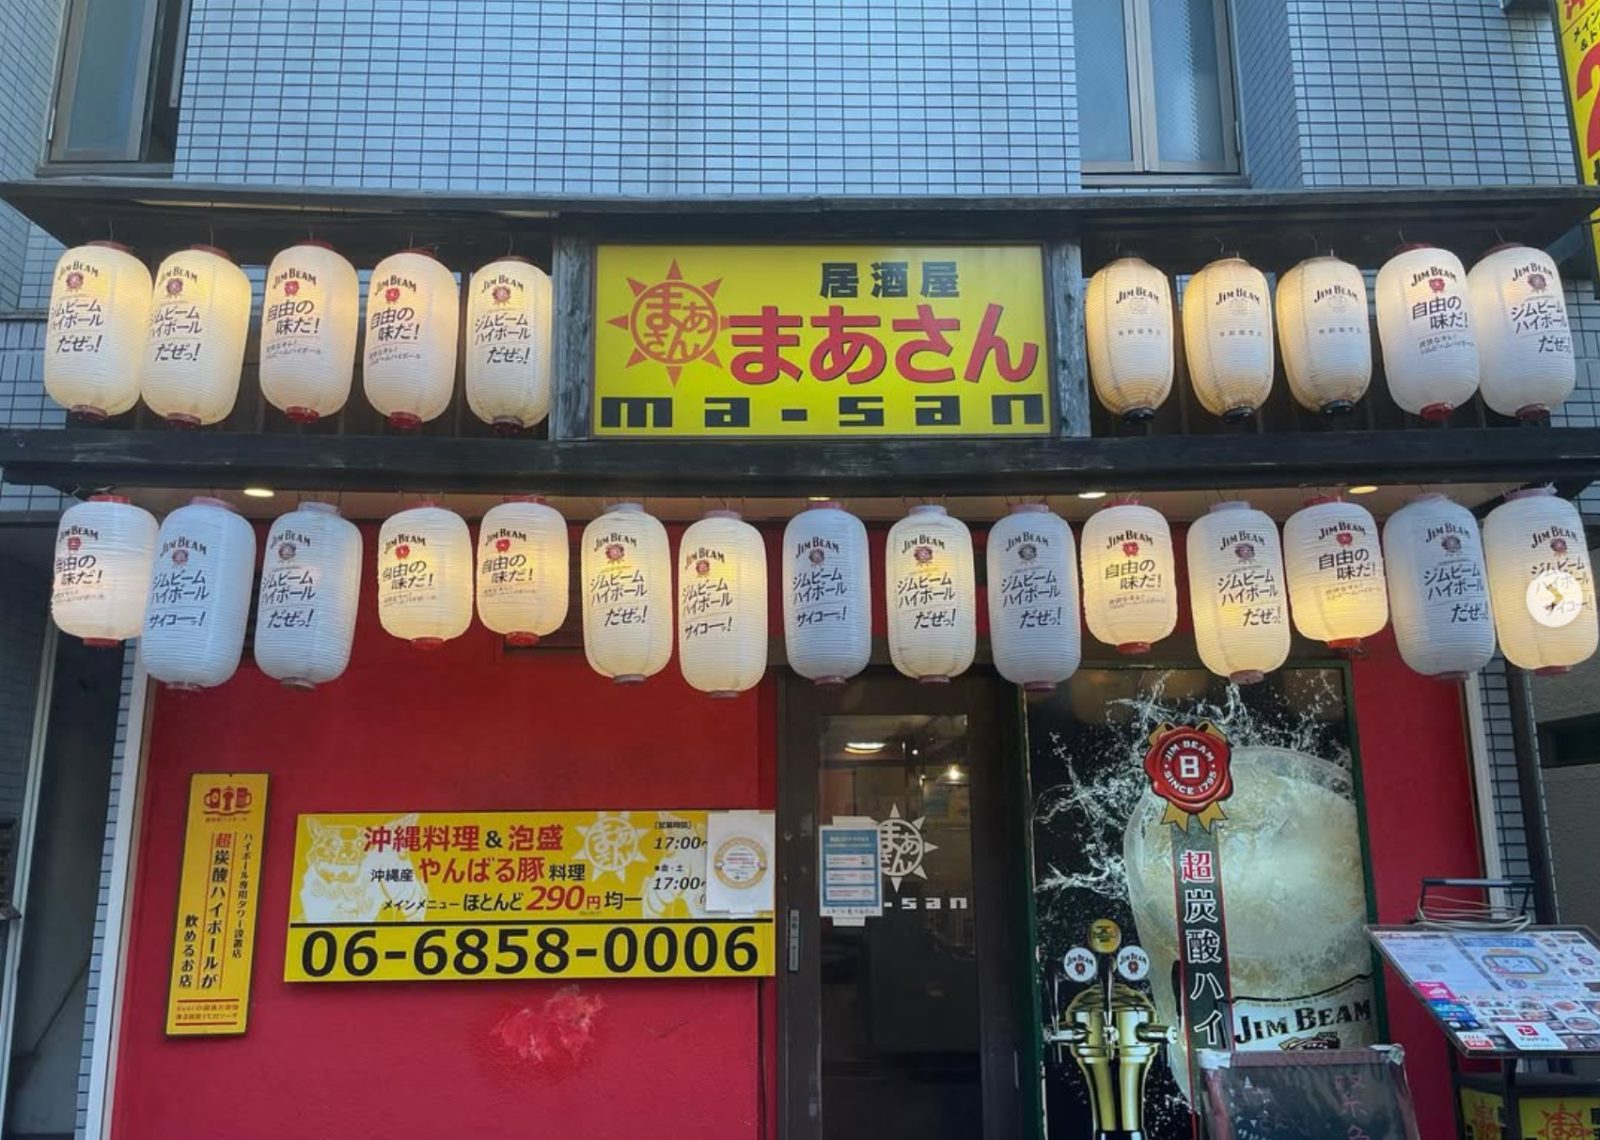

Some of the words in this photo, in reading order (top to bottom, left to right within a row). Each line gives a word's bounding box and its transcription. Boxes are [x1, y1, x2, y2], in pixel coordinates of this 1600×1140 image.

[289, 267, 316, 286] BEAM
[390, 274, 416, 292] BEAM
[498, 274, 524, 292] BEAM
[819, 261, 960, 298] 居酒屋
[1411, 270, 1430, 287] JIM
[1430, 266, 1457, 283] BEAM
[1512, 266, 1529, 281] JIM
[1116, 289, 1134, 304] JIM
[1136, 287, 1159, 304] BEAM
[1216, 291, 1234, 305] JIM
[1236, 288, 1260, 304] BEAM
[1314, 288, 1332, 303] JIM
[1334, 285, 1358, 301] BEAM
[267, 299, 315, 322] 自由の
[370, 306, 415, 330] 自由の
[1412, 296, 1461, 320] 自由の
[1511, 300, 1563, 321] ジムビーム
[275, 317, 320, 335] 味だ!
[475, 312, 528, 333] ジムビーム
[1430, 311, 1468, 329] 味だ!
[378, 323, 420, 342] 味だ!
[475, 325, 531, 345] ハイボール
[728, 302, 1040, 385] まあさん
[600, 393, 1045, 428] ma-san
[71, 525, 98, 541] BEAM
[285, 530, 310, 547] BEAM
[398, 533, 425, 546] BEAM
[500, 528, 527, 542] BEAM
[611, 532, 637, 547] BEAM
[1107, 534, 1124, 549] JIM
[1125, 530, 1153, 546] BEAM
[1220, 534, 1237, 551] JIM
[1239, 530, 1265, 546] BEAM
[1319, 525, 1337, 540] JIM
[1338, 521, 1366, 536] BEAM
[1425, 526, 1443, 543] JIM
[1531, 530, 1550, 549] JIM
[1551, 525, 1578, 541] BEAM
[178, 536, 206, 555] BEAM
[796, 541, 811, 559] JIM
[812, 536, 840, 553] BEAM
[902, 538, 917, 554] JIM
[919, 534, 945, 549] BEAM
[1006, 536, 1021, 552] JIM
[1023, 531, 1049, 547] BEAM
[482, 554, 527, 574] 自由の
[698, 547, 725, 564] BEAM
[1318, 548, 1369, 570] 自由の
[382, 561, 427, 581] 自由の
[491, 568, 533, 583] 味だ!
[793, 568, 842, 590] ジムビーム
[1105, 559, 1156, 579] 自由の
[1336, 561, 1376, 580] 味だ!
[1424, 562, 1480, 586] ジムビーム
[153, 569, 206, 591] ジムビーム
[391, 573, 433, 590] 味だ!
[590, 569, 644, 592] ジムビーム
[683, 578, 728, 603] ジムビーム
[897, 571, 953, 595] ジムビーム
[1001, 570, 1057, 593] ジムビーム
[1120, 574, 1161, 590] 味だ!
[1218, 568, 1274, 593] ジムビーム
[1427, 578, 1484, 601] ハイボール
[151, 583, 210, 605] ハイボール
[591, 584, 648, 606] ハイボール
[683, 592, 733, 616] ハイボール
[793, 582, 847, 605] ハイボール
[899, 586, 955, 608] ハイボール
[1003, 584, 1060, 608] ハイボール
[1222, 584, 1278, 607] ハイボール
[914, 608, 956, 630] だぜっ!
[1020, 606, 1061, 629] だぜっ!
[1165, 744, 1179, 761] JIM
[1182, 740, 1214, 761] BEAM
[1179, 755, 1200, 778] B
[1164, 771, 1195, 795] SINCE
[363, 825, 480, 853] 沖縄料理
[485, 831, 503, 848] &
[508, 824, 564, 852] 泡盛
[371, 869, 414, 883] 沖縄産
[419, 857, 545, 883] やんばる豚
[549, 864, 585, 881] 料理
[201, 833, 232, 988] 超炭酸ハイボールが
[383, 899, 459, 910] メインメニュー
[463, 893, 524, 911] ほとんど
[179, 914, 199, 988] 飲めるお店
[302, 926, 758, 977] 06-6858-0006
[1180, 849, 1225, 1046] 超炭酸ハイ
[1235, 1016, 1288, 1044] JIM
[1295, 999, 1371, 1031] BEAM
